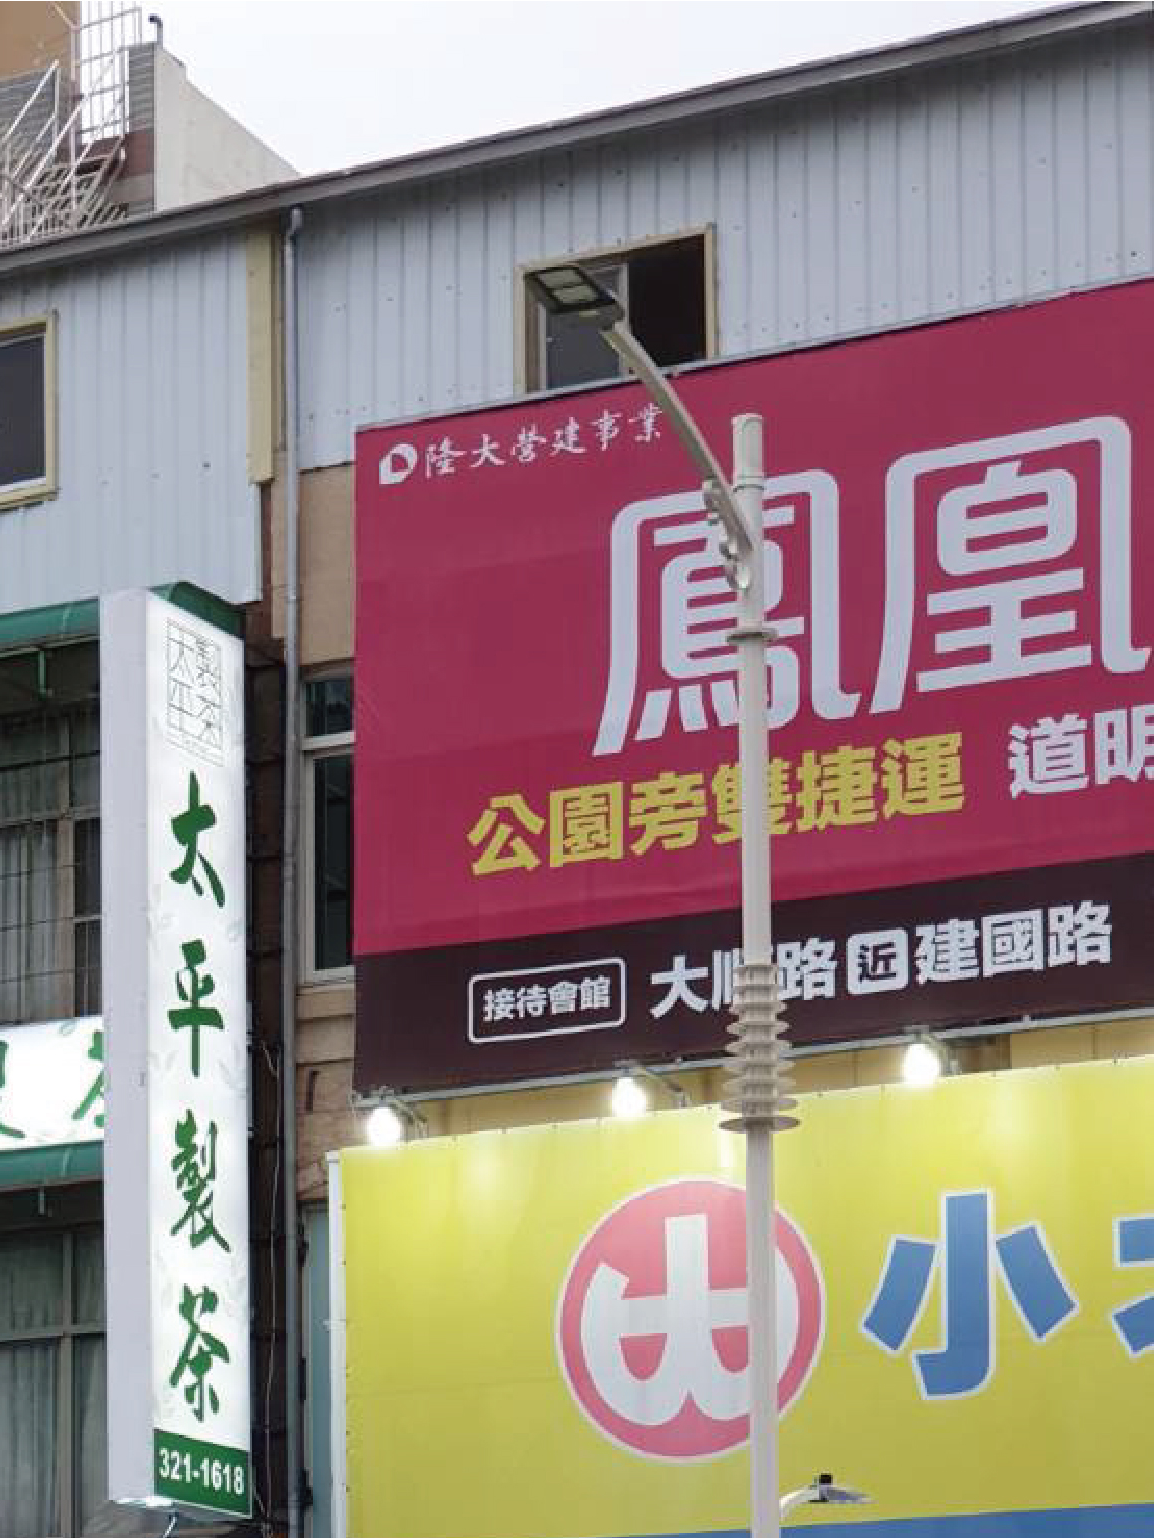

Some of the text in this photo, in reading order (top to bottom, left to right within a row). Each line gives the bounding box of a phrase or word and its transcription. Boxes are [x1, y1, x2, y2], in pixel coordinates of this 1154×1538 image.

[592, 415, 1153, 757] 鳳凰
[467, 732, 965, 877] 公園旁雙捷運
[482, 976, 612, 1022] 接待會館
[168, 770, 231, 1423] 太平製茶
[860, 1188, 1154, 1400] 小
[158, 1447, 245, 1496] 321-1618
